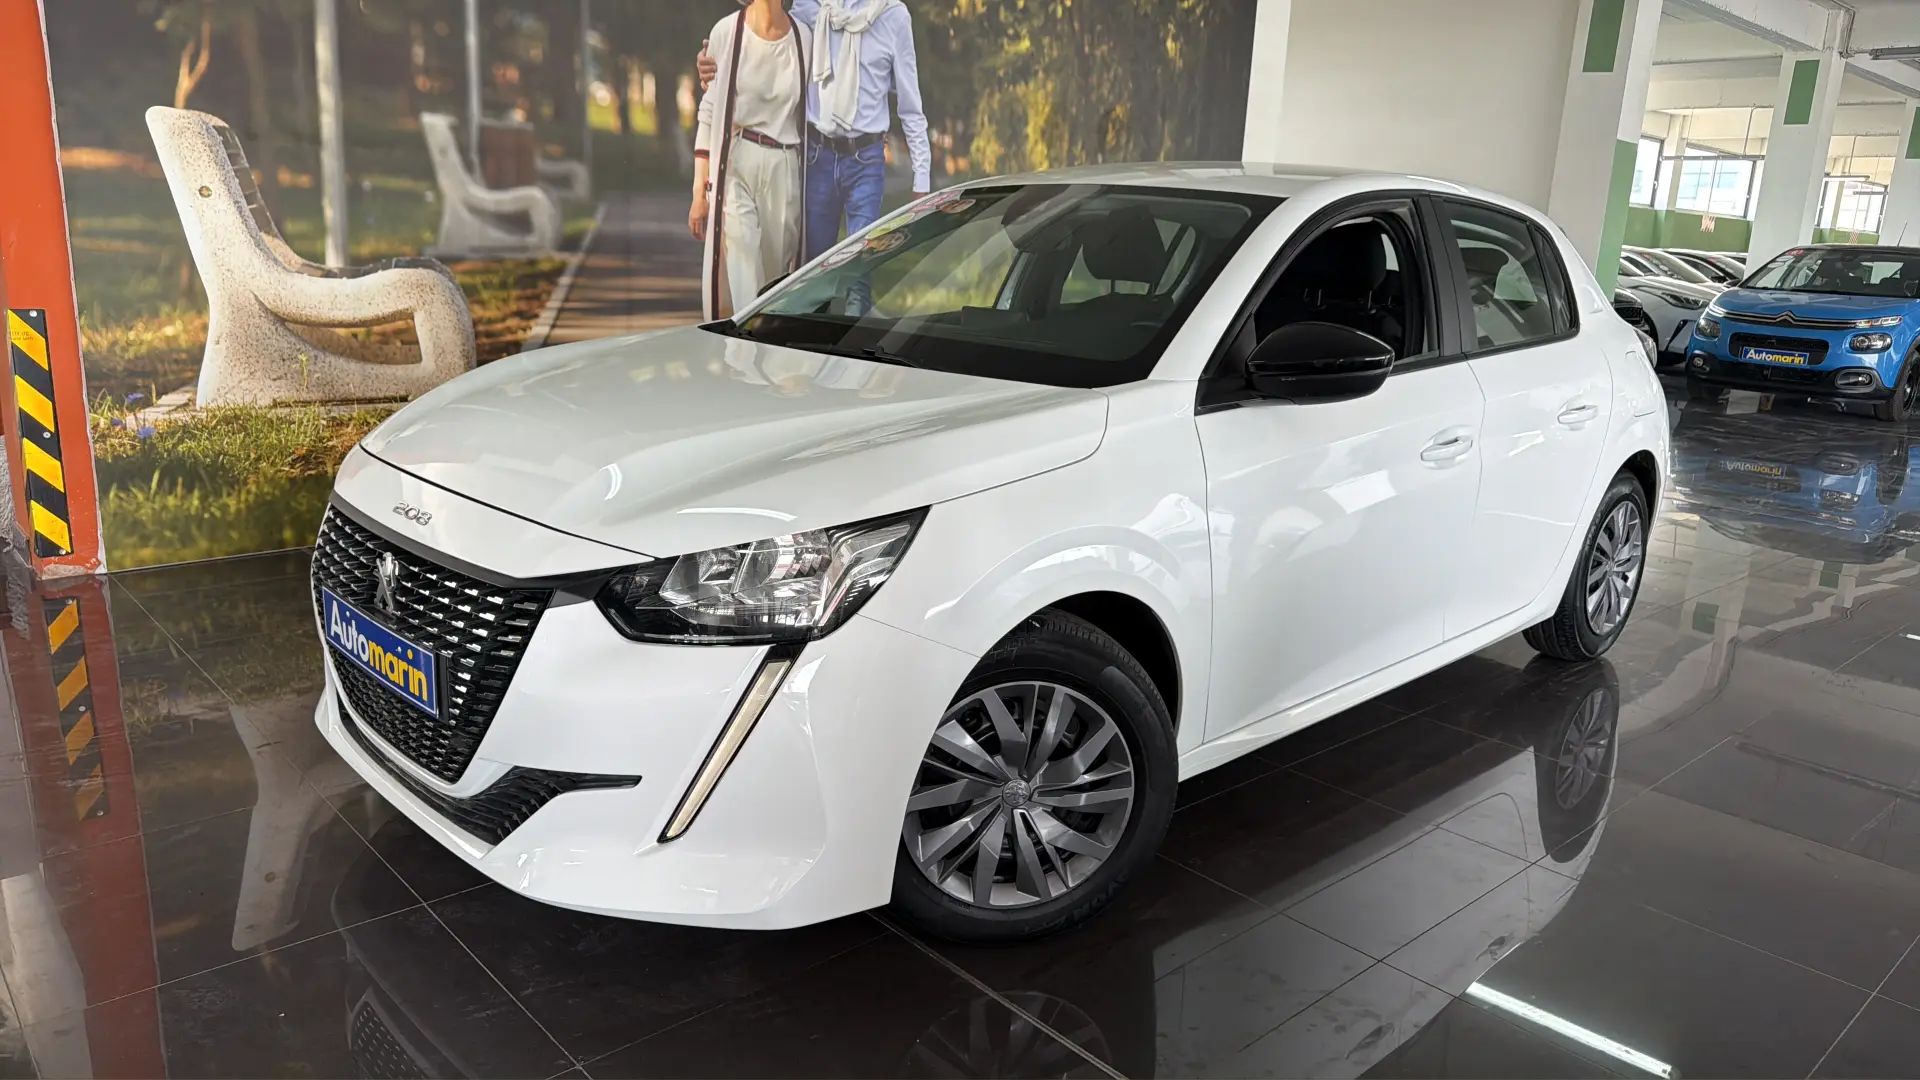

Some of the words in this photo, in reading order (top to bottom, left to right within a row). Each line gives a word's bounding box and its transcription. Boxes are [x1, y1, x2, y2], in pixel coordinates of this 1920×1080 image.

[1746, 349, 1804, 364] Automarin
[392, 500, 432, 526] 208
[330, 599, 428, 702] Automarin
